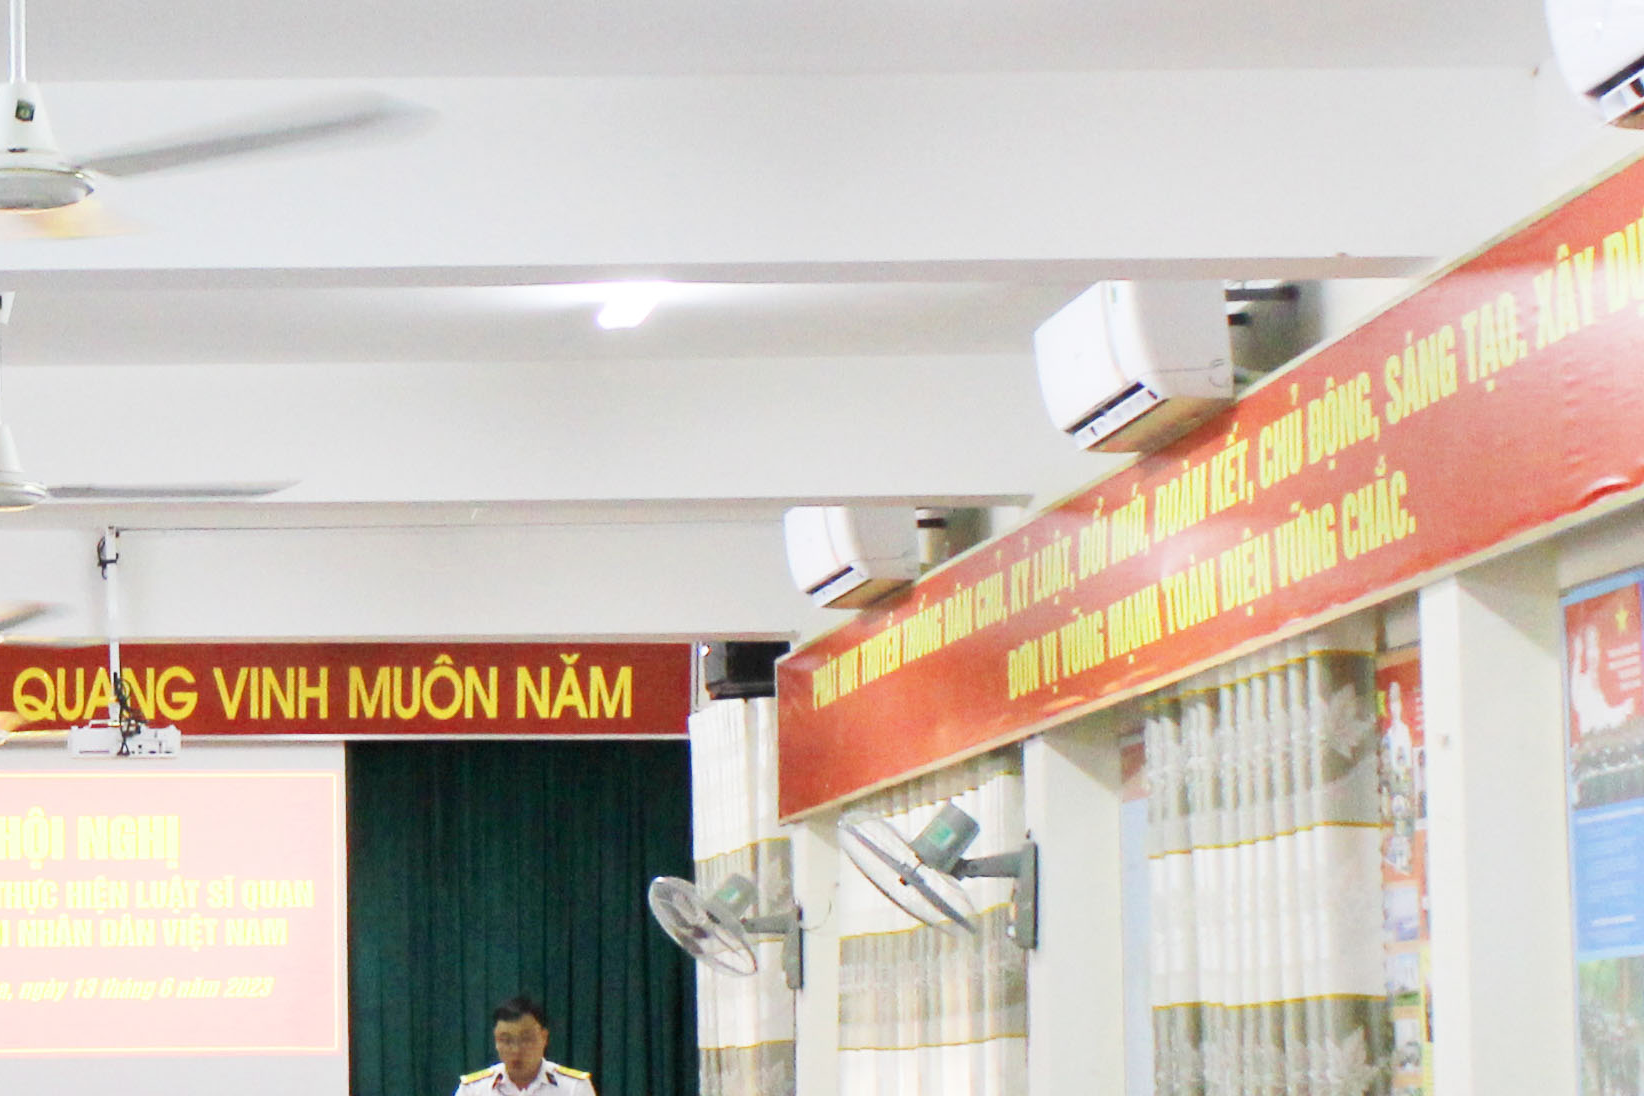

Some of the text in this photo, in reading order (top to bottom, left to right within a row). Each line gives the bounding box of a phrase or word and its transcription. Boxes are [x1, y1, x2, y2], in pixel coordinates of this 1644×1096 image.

[860, 611, 901, 685] TRUYỀN
[902, 593, 943, 664] THỐNG
[944, 582, 973, 645] DÂN
[975, 549, 1008, 630] CHỦ,
[1011, 535, 1031, 614] KỶ
[1033, 529, 1076, 605] LUẬT,
[1078, 495, 1108, 580] ĐỔI
[1111, 482, 1150, 565] MỚI,
[1154, 459, 1207, 544] ĐOÀN
[1209, 421, 1254, 514] KẾT,
[1259, 383, 1303, 490] CHỦ
[1307, 371, 1380, 470] ĐỘNG,
[1384, 330, 1457, 425] SÁNG
[1532, 243, 1596, 350] XÂY
[1008, 454, 1416, 700] ĐƠN VỊ VỮNG MẠNH TOÀN DIỆN VỮNG CHẮC.
[13, 666, 199, 721] QUANG
[213, 667, 329, 720] VINH
[349, 654, 498, 720] MUÔN
[517, 653, 633, 719] NĂM
[76, 814, 180, 869] NGHỊ
[65, 874, 129, 914] HIỆN
[135, 874, 200, 914] LUẬT
[206, 874, 236, 909] SĨ
[240, 879, 315, 912] QUAN
[17, 912, 93, 947] NHÂN
[99, 912, 155, 947] DÂN
[161, 911, 219, 952] VIỆT
[224, 917, 288, 946] NAM
[18, 977, 69, 1003] ngày
[72, 976, 100, 999] 13
[100, 976, 157, 1002] tháng
[176, 976, 221, 999] năm
[223, 975, 276, 999] 2023
